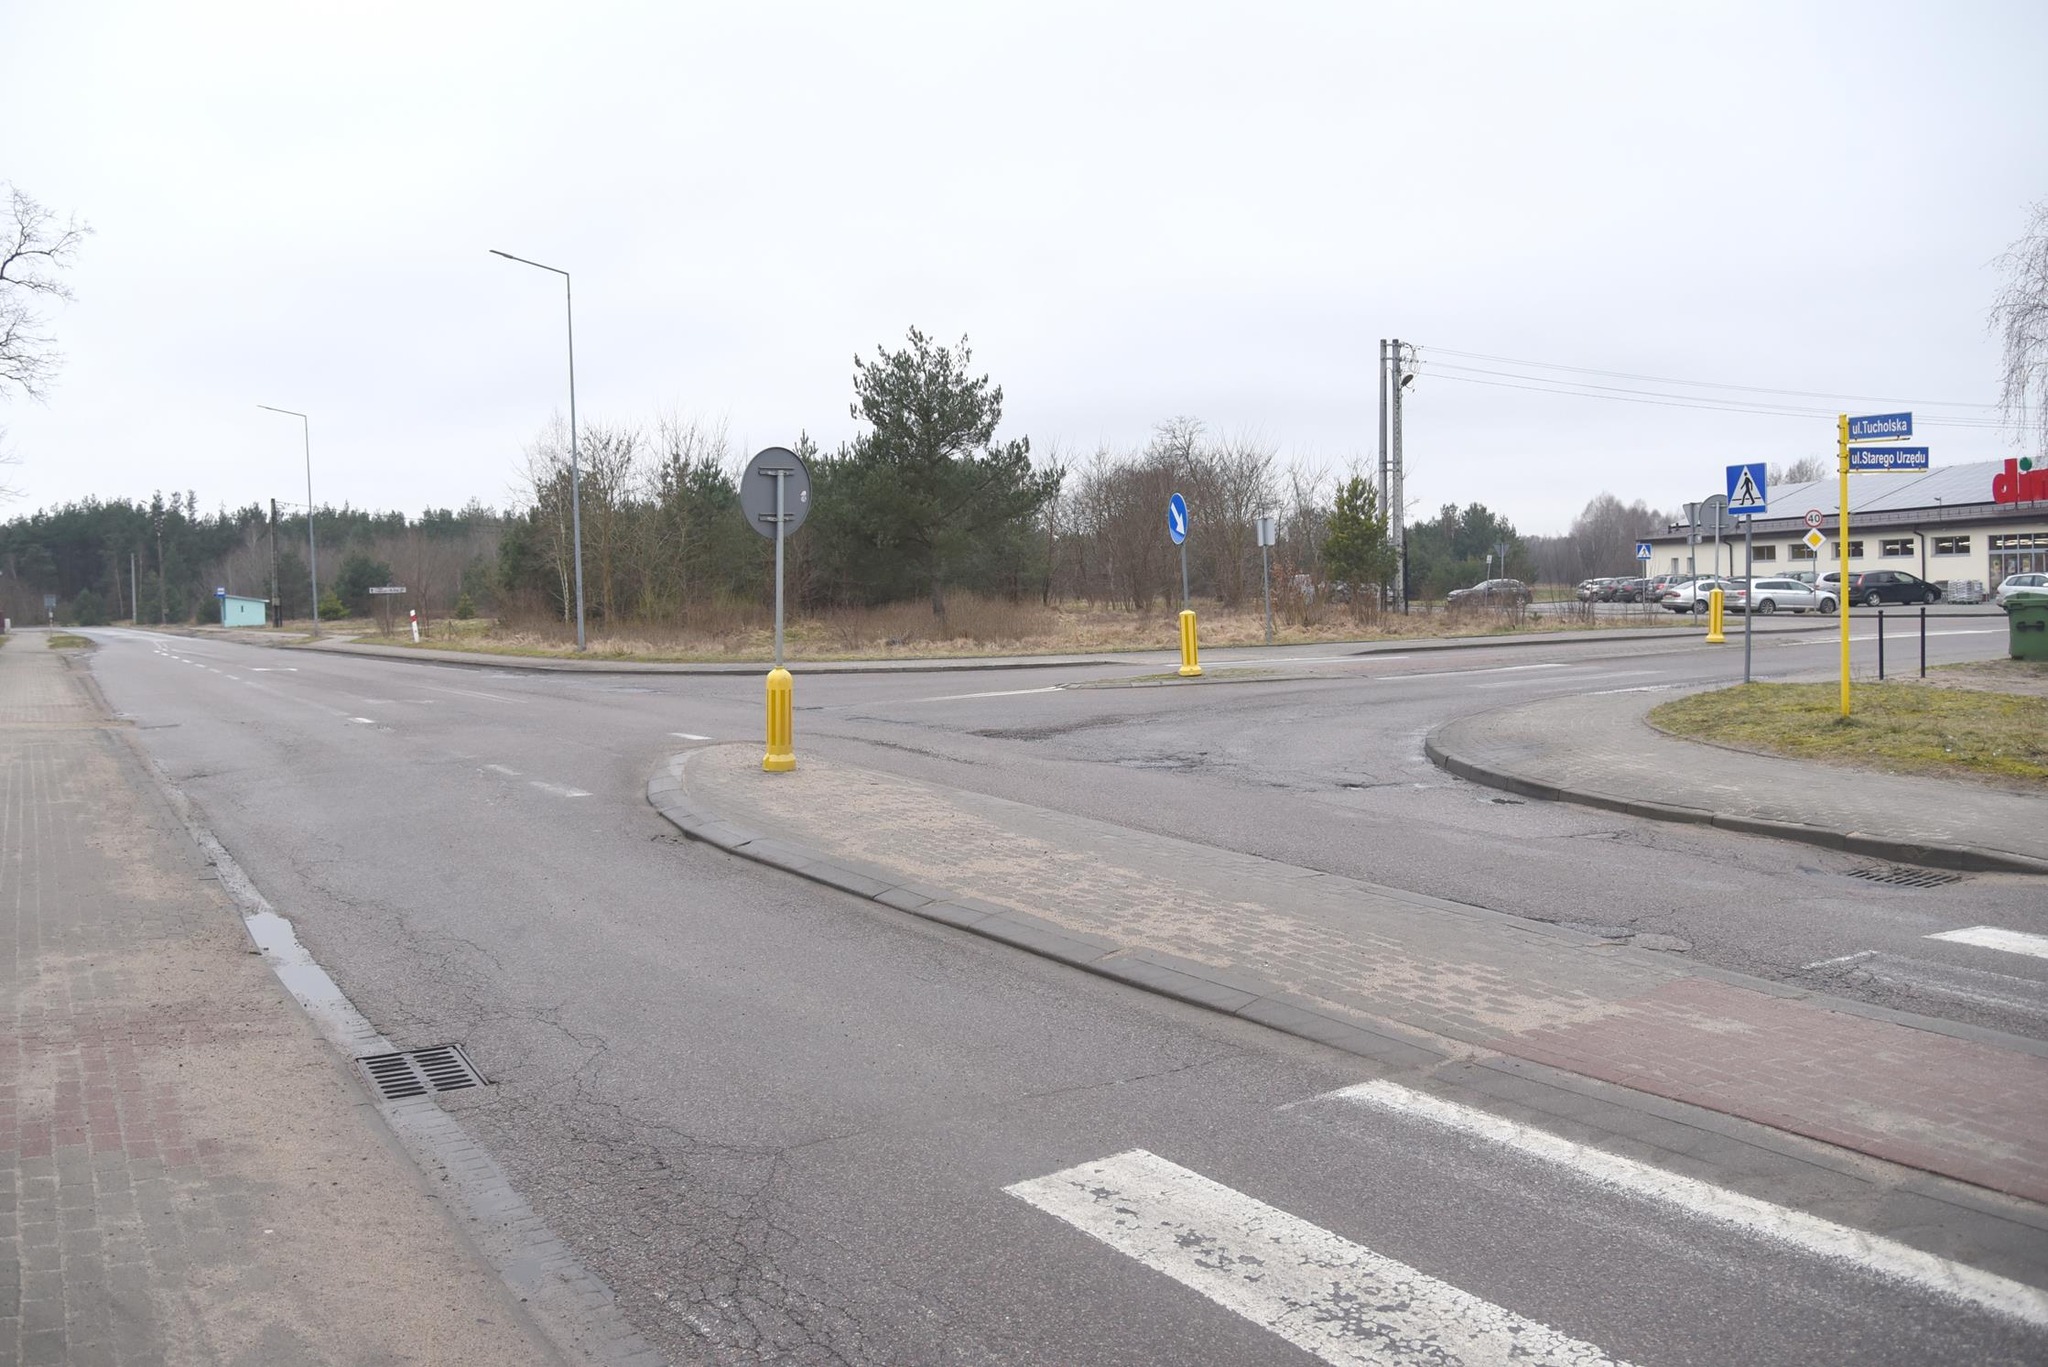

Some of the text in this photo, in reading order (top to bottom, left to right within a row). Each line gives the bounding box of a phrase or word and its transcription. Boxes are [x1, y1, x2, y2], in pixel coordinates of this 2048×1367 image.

[1852, 419, 1907, 434] ul.Tucholska
[1851, 450, 1926, 467] ul.Starego Urzędu
[1808, 514, 1820, 523] 40
